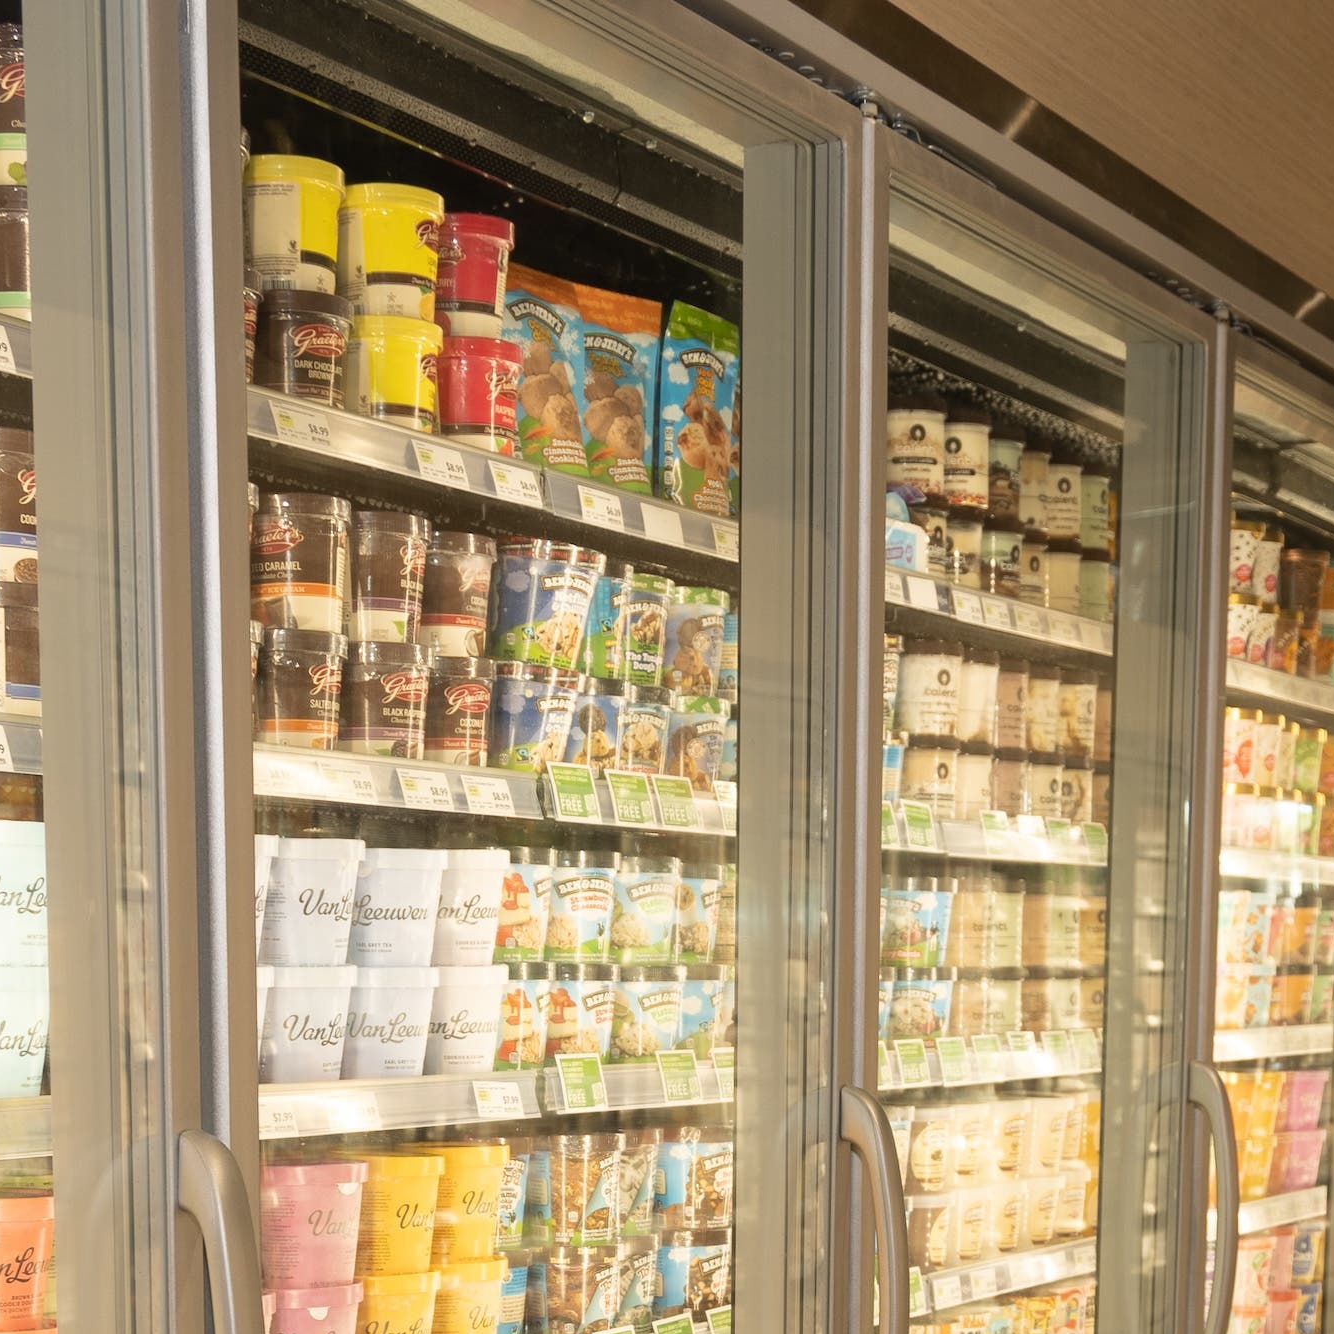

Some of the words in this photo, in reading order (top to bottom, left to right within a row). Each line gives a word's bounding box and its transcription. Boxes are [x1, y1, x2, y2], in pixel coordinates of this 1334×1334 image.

[308, 424, 329, 437] $8.99
[265, 560, 301, 571] CARAMEL
[430, 784, 449, 797] $8.99
[492, 791, 510, 803] $8.99
[561, 800, 583, 812] FREE
[618, 805, 640, 818] FREE
[354, 895, 427, 927] Leeuwen
